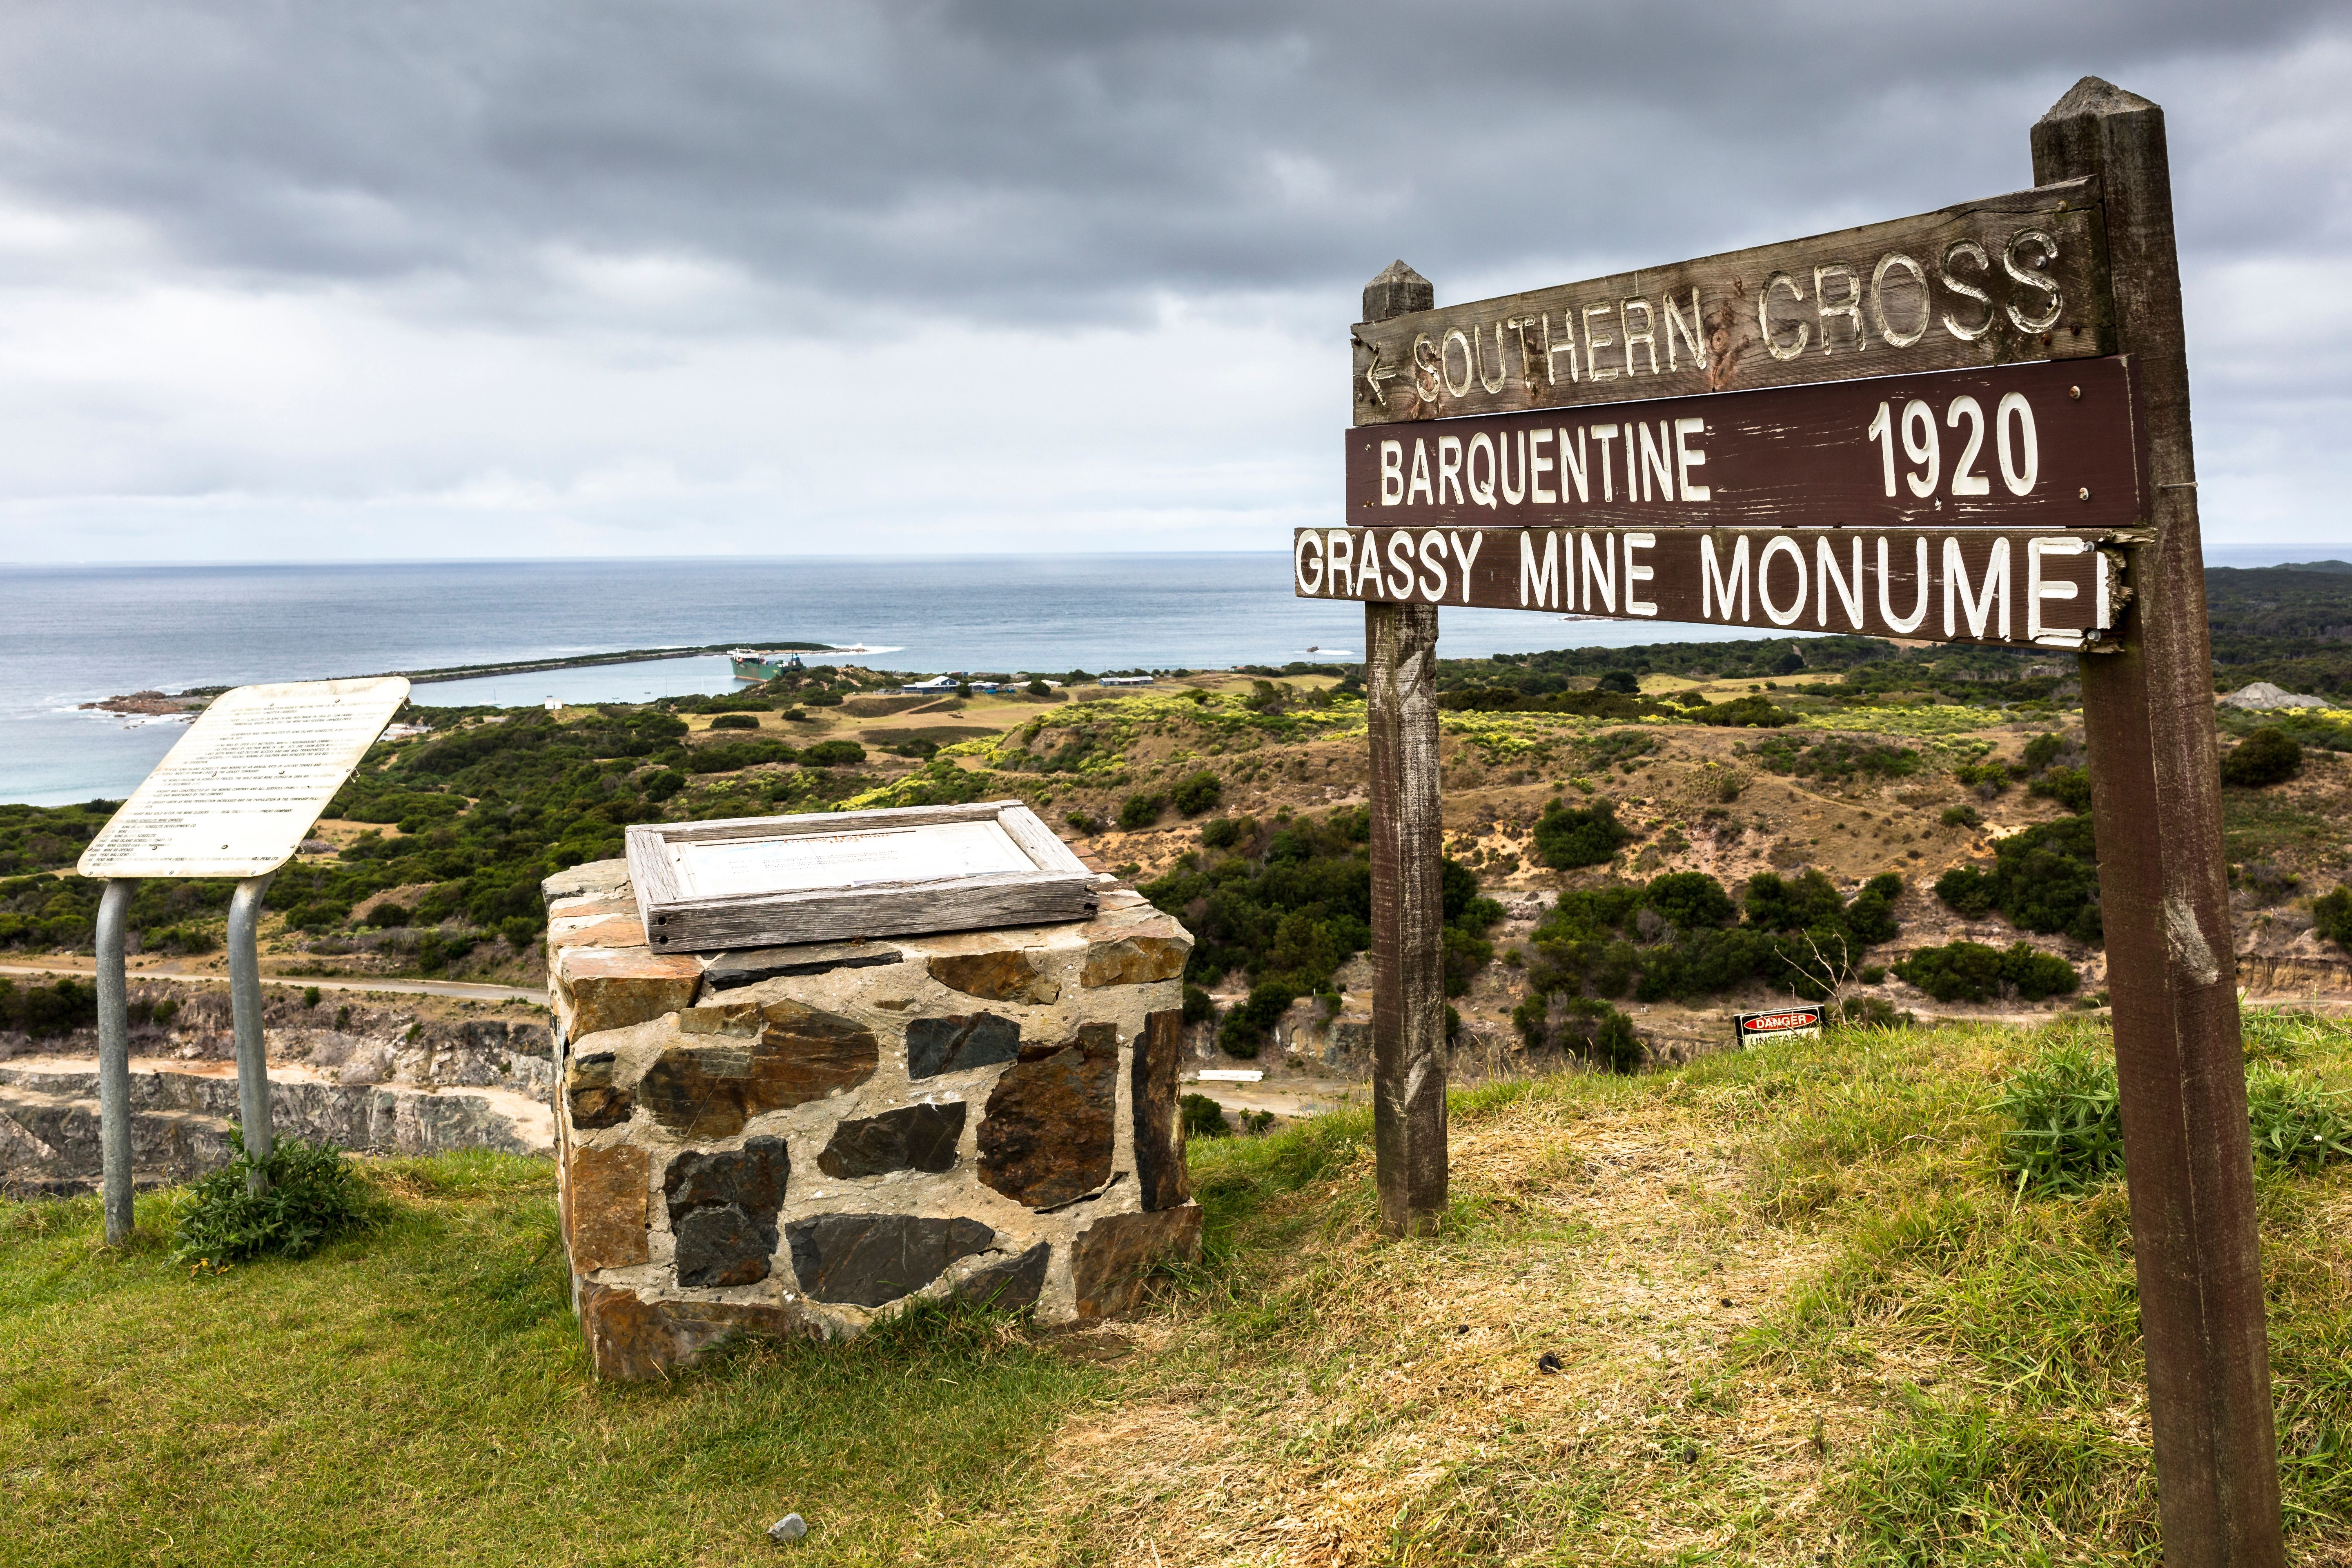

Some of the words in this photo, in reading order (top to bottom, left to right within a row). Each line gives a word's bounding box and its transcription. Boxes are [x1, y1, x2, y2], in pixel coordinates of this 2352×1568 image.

[1413, 285, 1708, 403] SOUTHERN
[1758, 226, 2063, 362] CROSS
[1381, 417, 1711, 510] BARQUENTINE
[1868, 391, 2038, 498] 1920
[1295, 528, 1483, 603] GRASSY
[1520, 530, 1657, 616] MINE
[1756, 1015, 1806, 1029] DANGER
